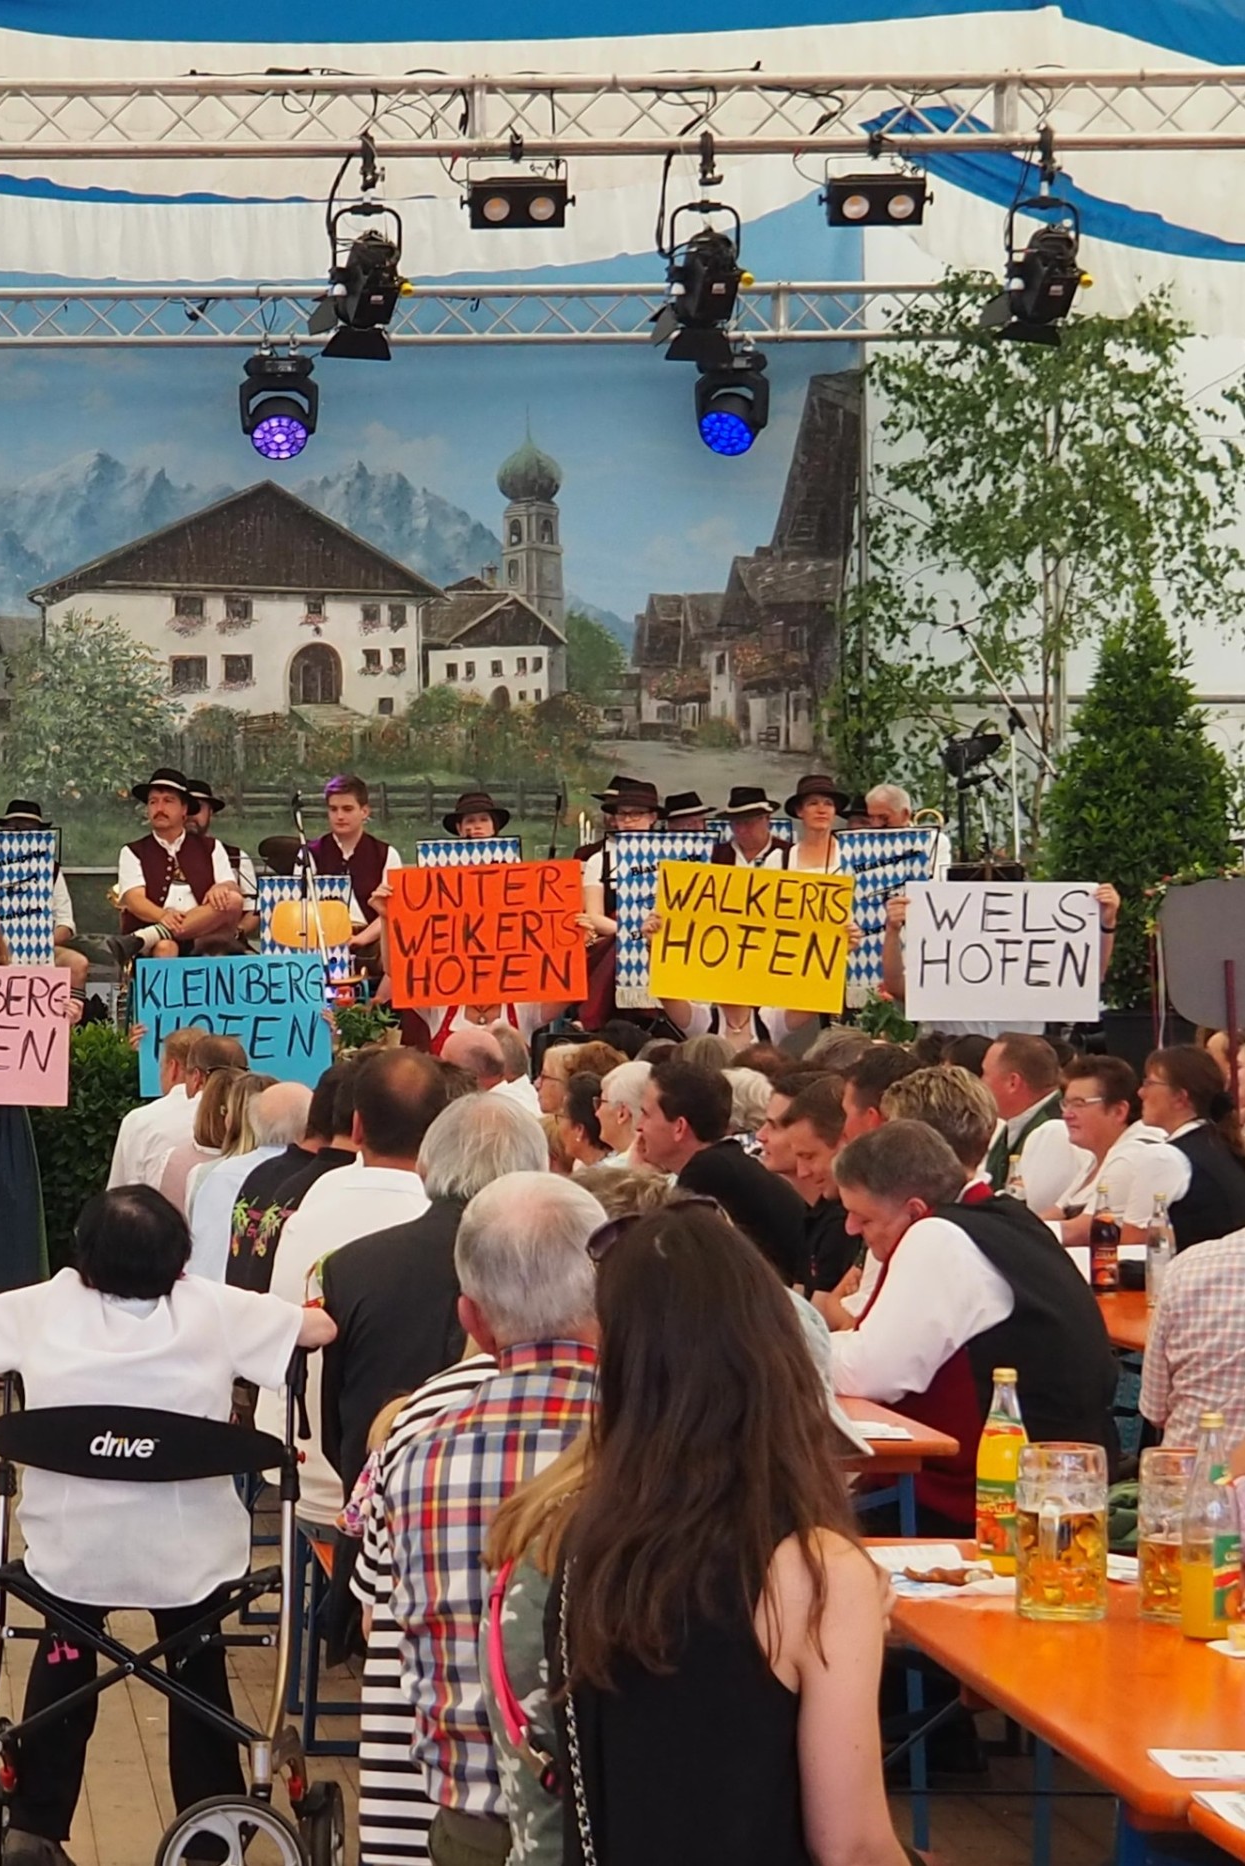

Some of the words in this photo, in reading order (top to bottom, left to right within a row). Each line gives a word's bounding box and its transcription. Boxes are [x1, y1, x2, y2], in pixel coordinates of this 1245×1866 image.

[402, 866, 577, 911] UNTER-
[662, 868, 851, 925] WALKERTS
[925, 889, 1096, 933] WELS-
[392, 910, 581, 957] WEIKERTS
[660, 918, 841, 980] HOFEN
[140, 962, 324, 1010] KLEINBERG
[406, 951, 572, 998] HOFEN
[919, 937, 1090, 988] HOFEN
[89, 1431, 155, 1458] drive
